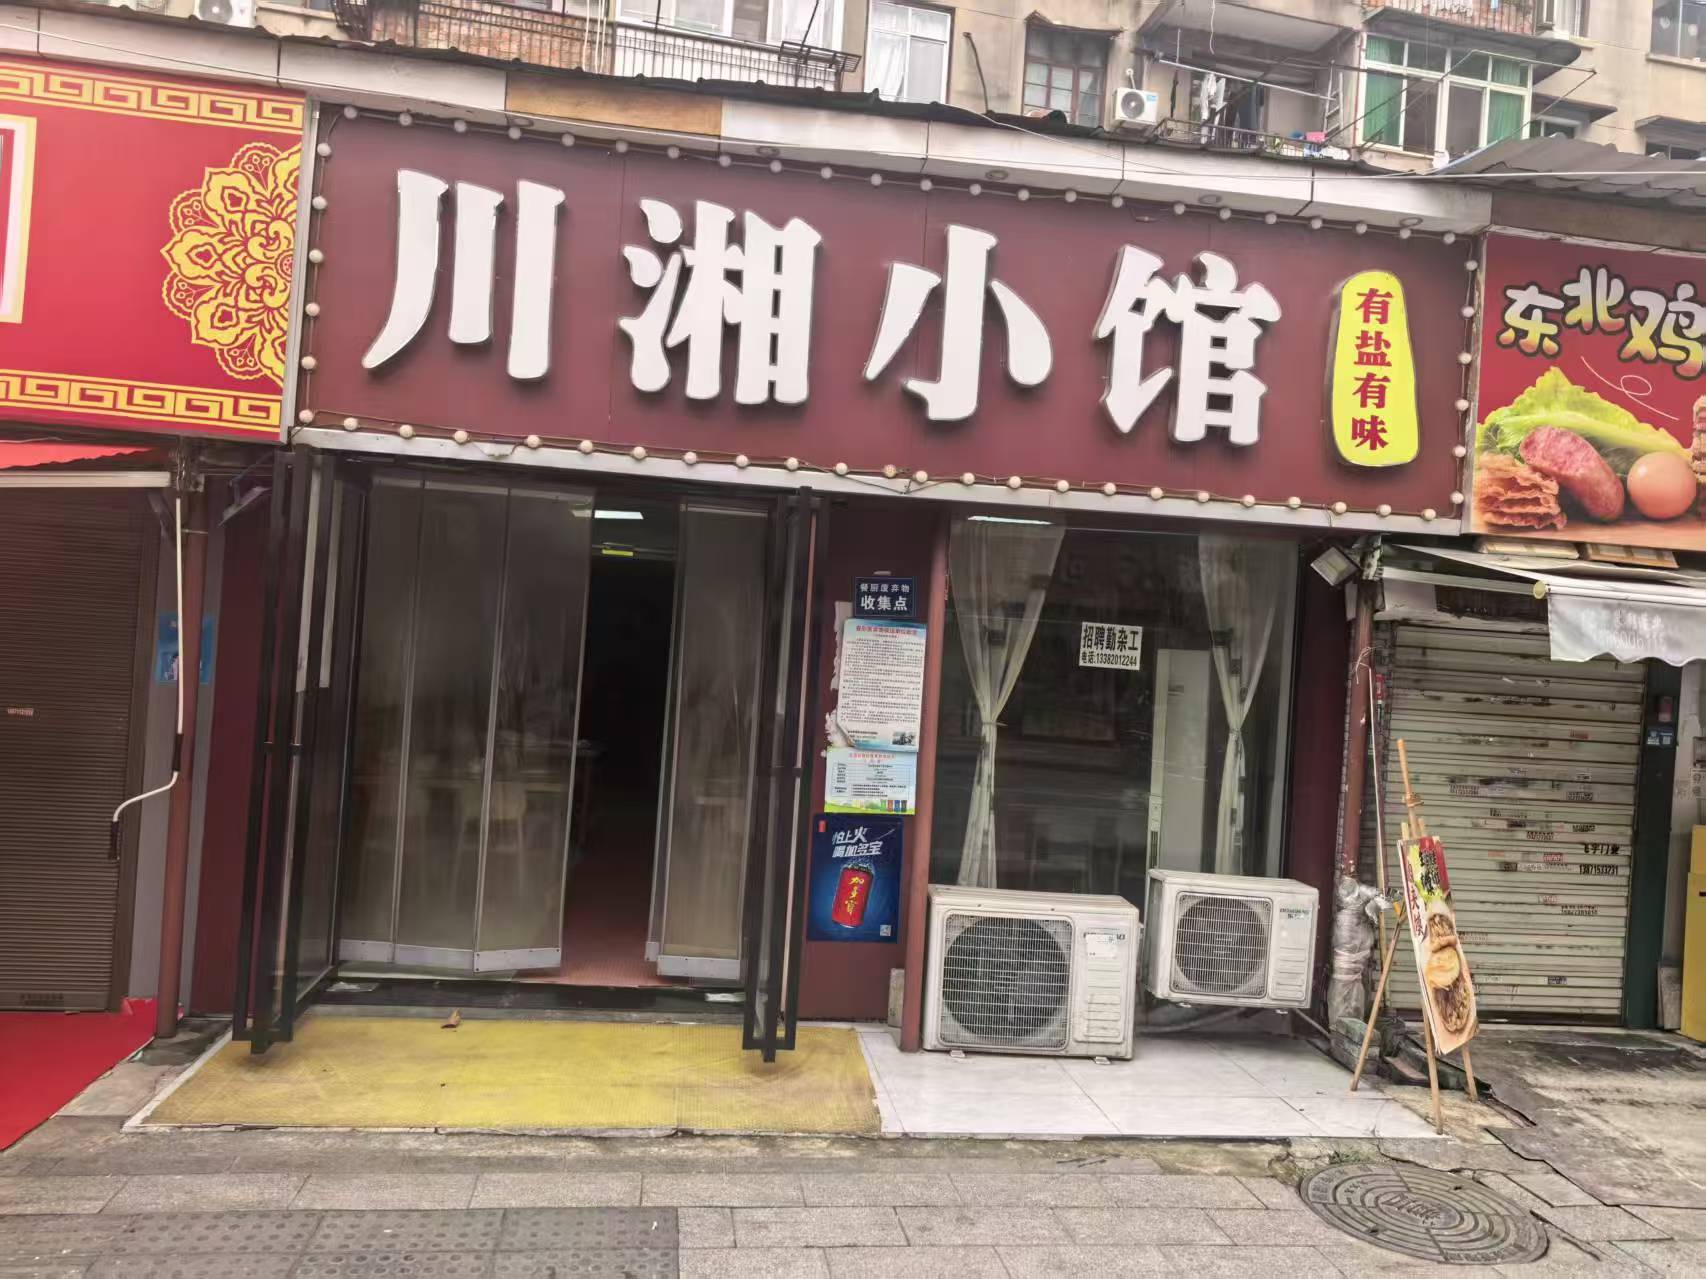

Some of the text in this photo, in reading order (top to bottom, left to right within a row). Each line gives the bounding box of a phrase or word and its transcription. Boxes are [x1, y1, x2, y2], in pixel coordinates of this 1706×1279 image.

[361, 169, 1282, 446] 川湘小馆
[1351, 287, 1394, 451] 有盐有味
[860, 595, 908, 611] 收集点
[832, 826, 868, 845] 怕上火
[832, 841, 883, 858] 喝加多宝
